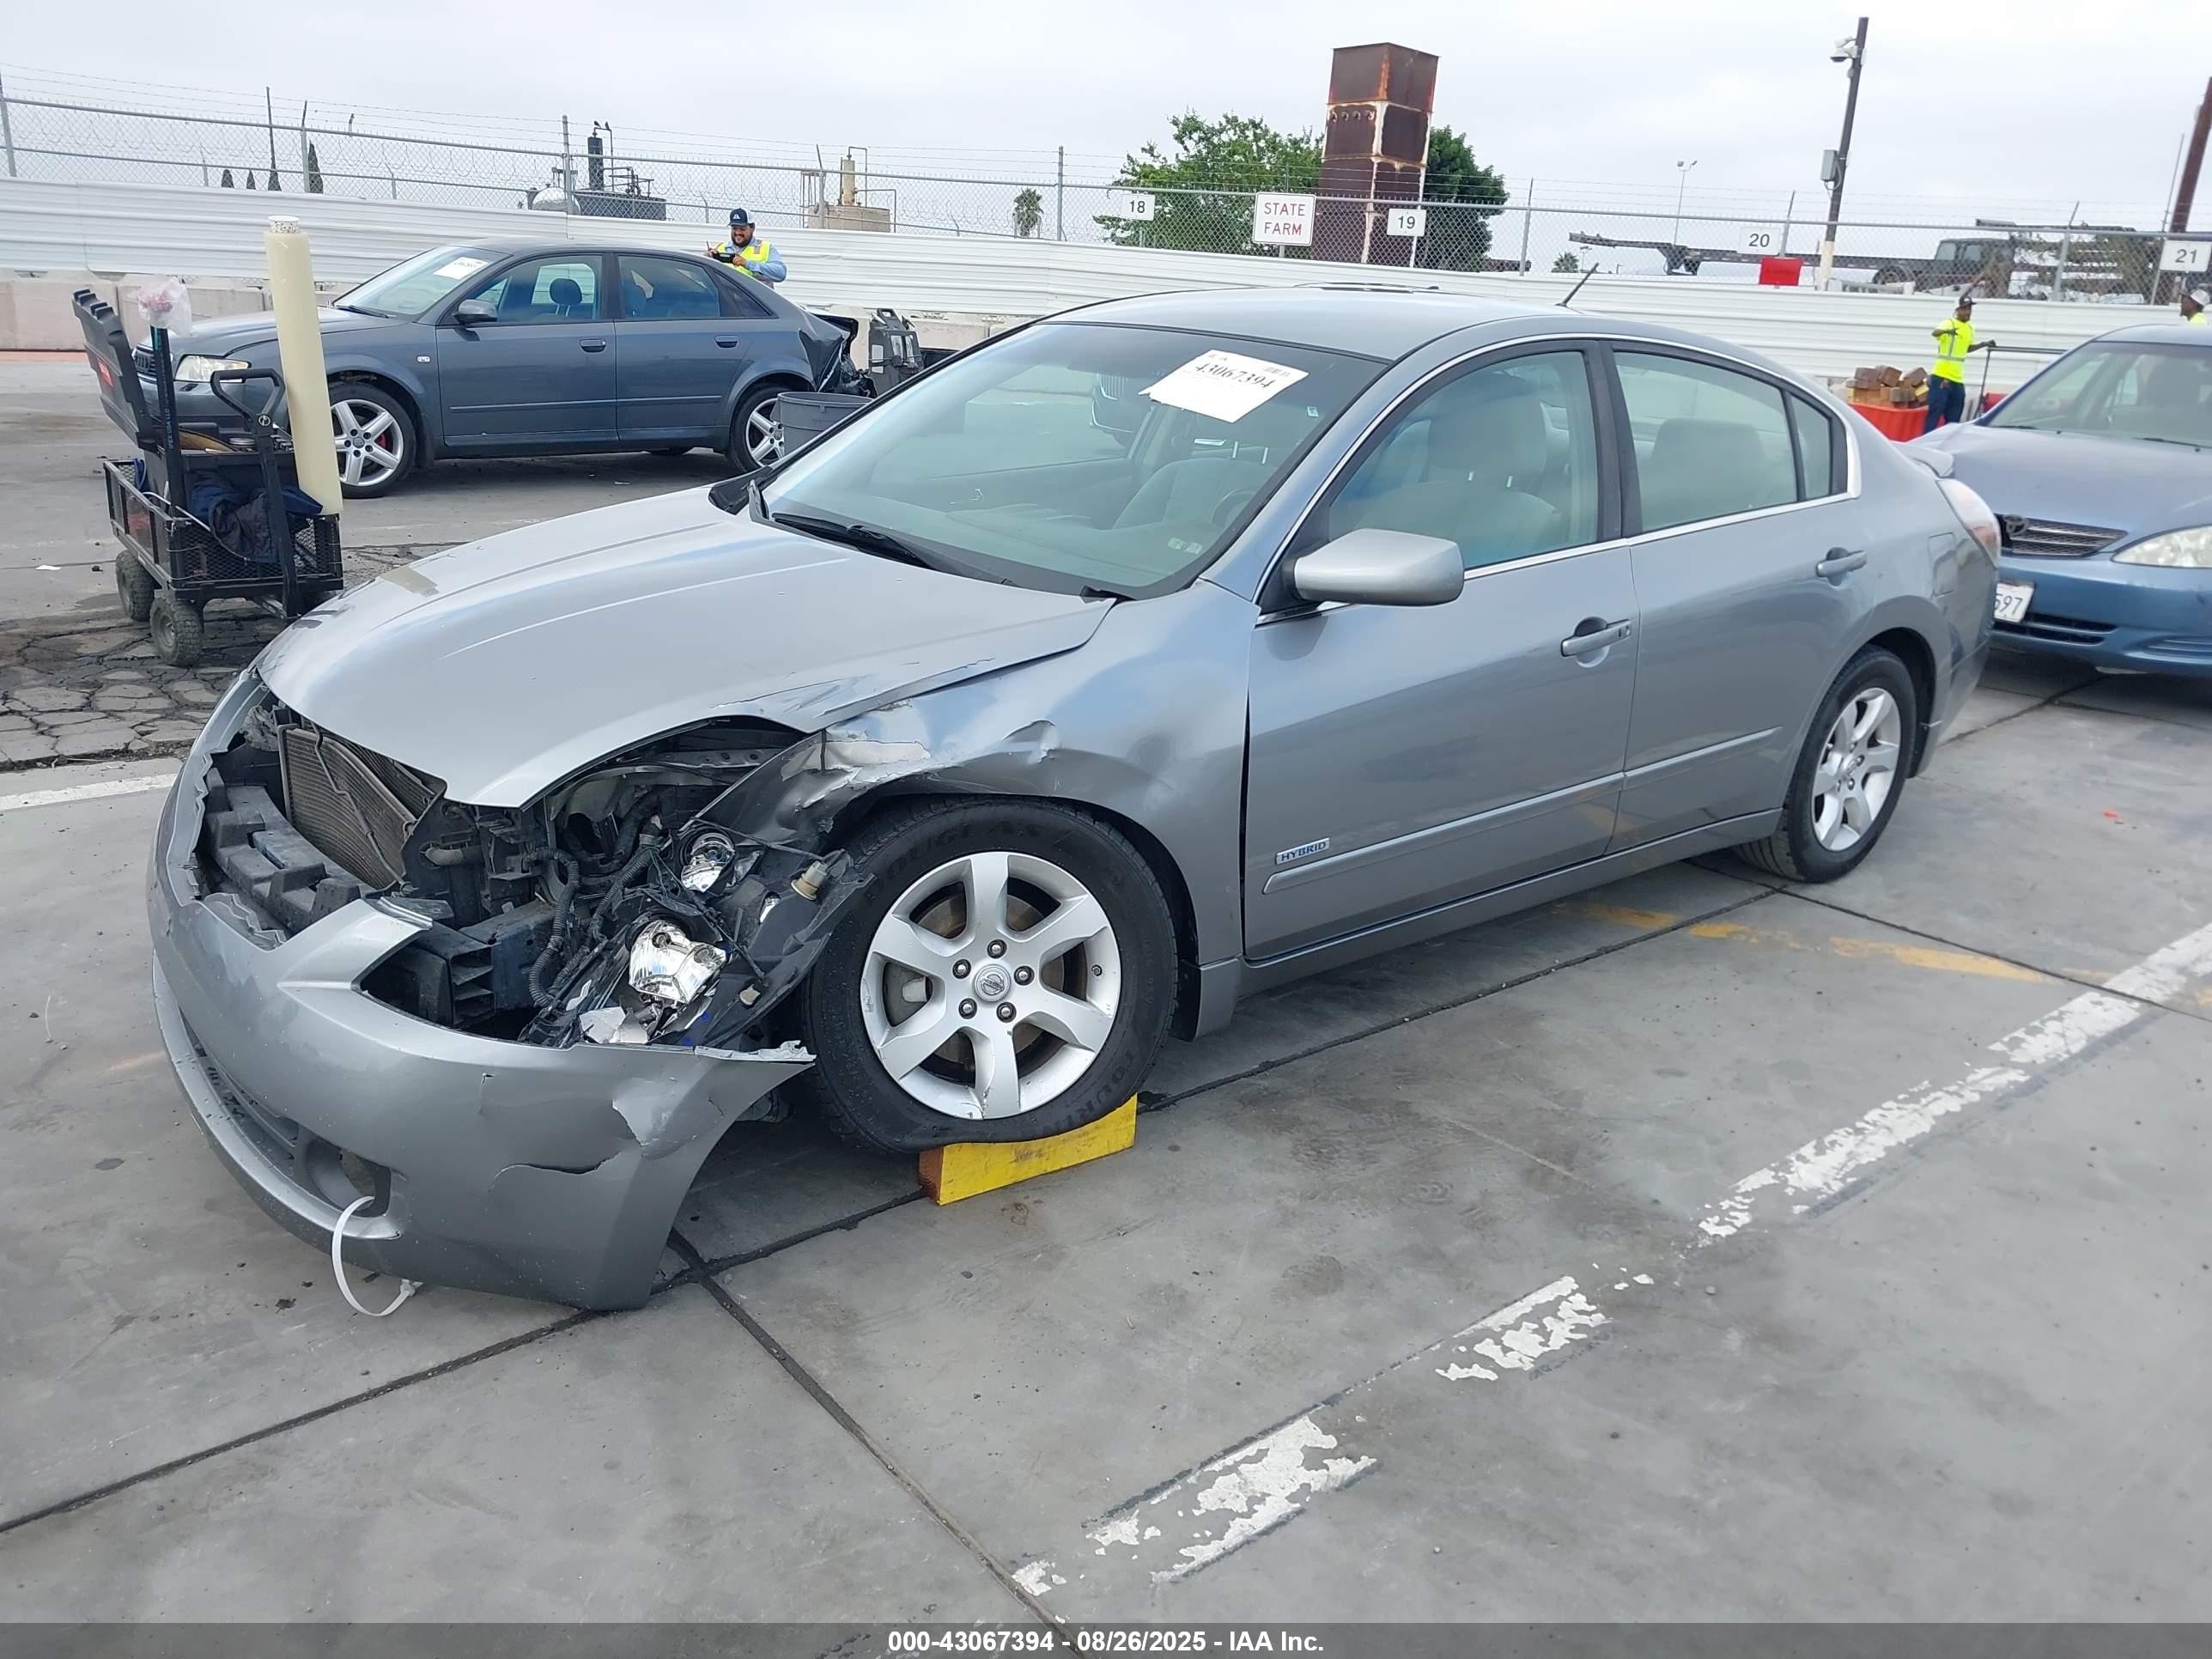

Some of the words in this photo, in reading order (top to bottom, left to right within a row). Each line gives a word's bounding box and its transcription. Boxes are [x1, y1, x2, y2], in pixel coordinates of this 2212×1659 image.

[1129, 200, 1146, 214] 18
[1264, 202, 1306, 216] STATE
[1263, 222, 1302, 236] FARM
[1397, 216, 1416, 229] 19
[1748, 233, 1770, 247] 20
[2174, 248, 2197, 264] 21
[1194, 362, 1277, 388] 43067394
[1280, 842, 1327, 861] HYBRID
